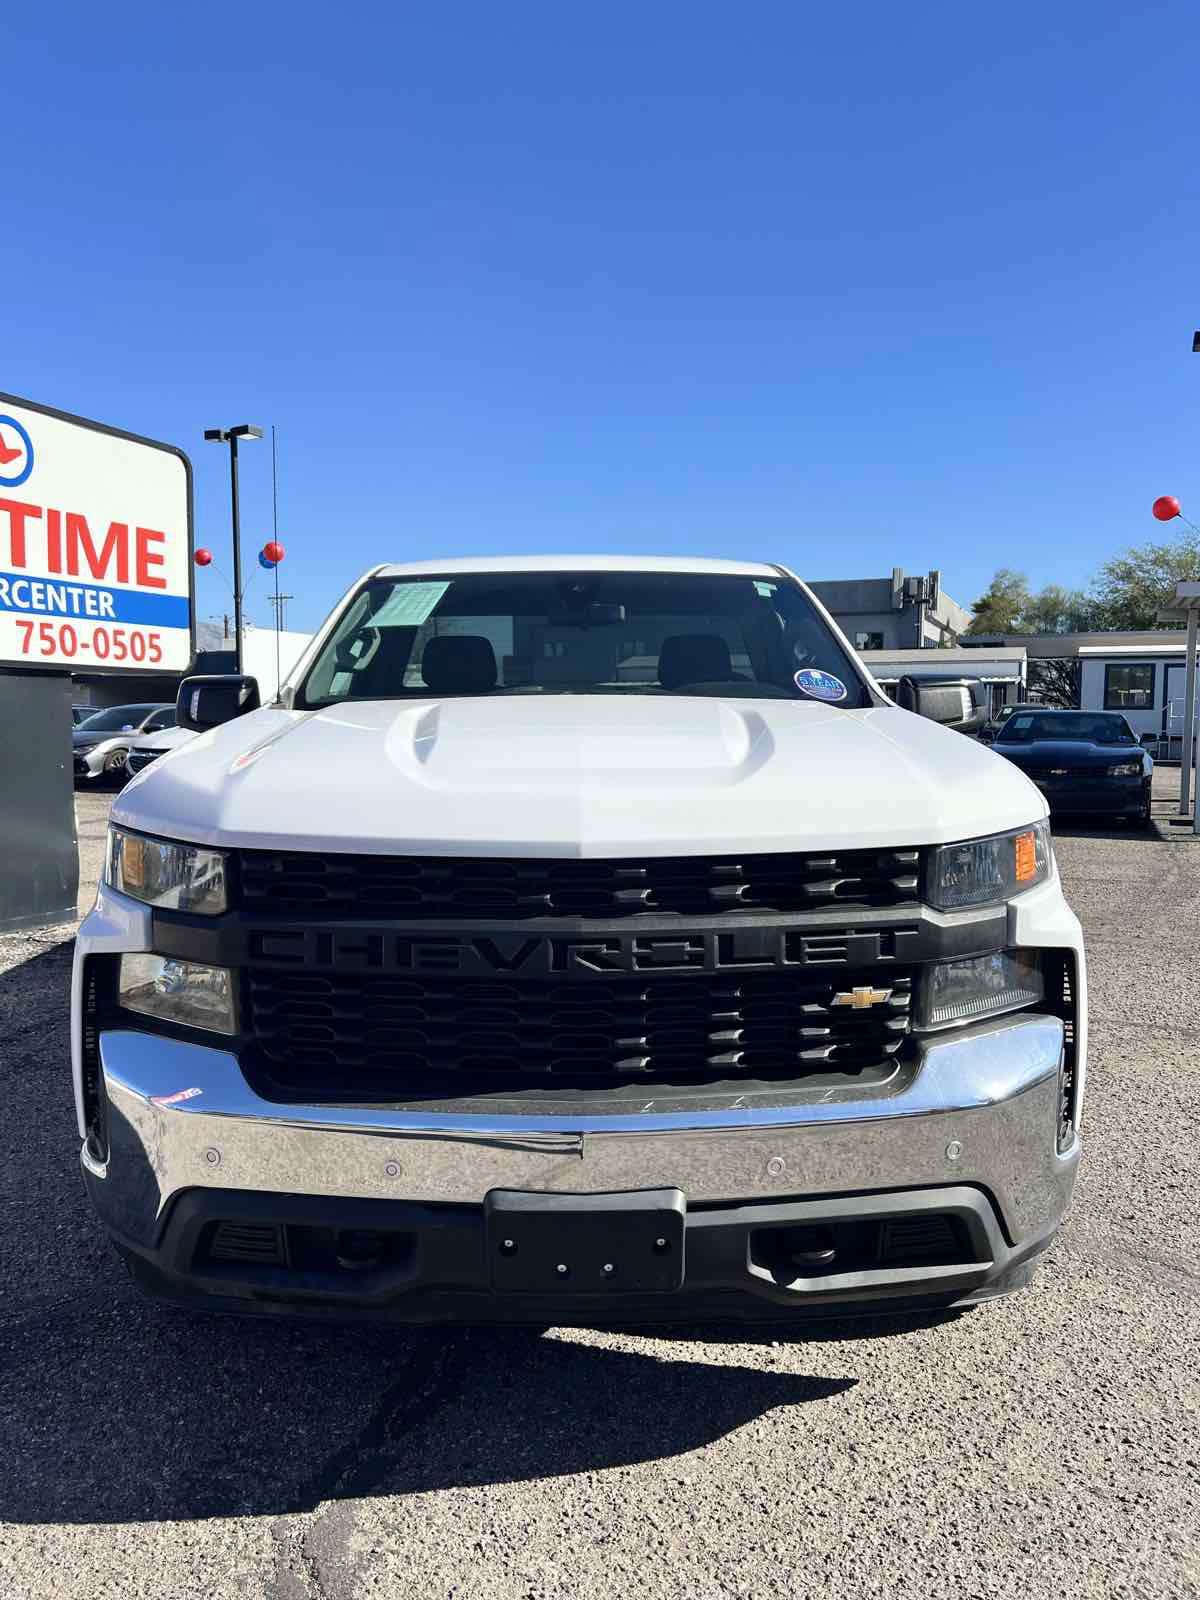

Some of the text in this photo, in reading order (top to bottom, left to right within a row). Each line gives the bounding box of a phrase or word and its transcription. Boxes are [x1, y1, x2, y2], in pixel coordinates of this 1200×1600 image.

[0, 498, 167, 589] TIME
[15, 620, 163, 662] 750-0505
[810, 677, 840, 689] YEAR
[248, 925, 919, 972] CHEVROLET
